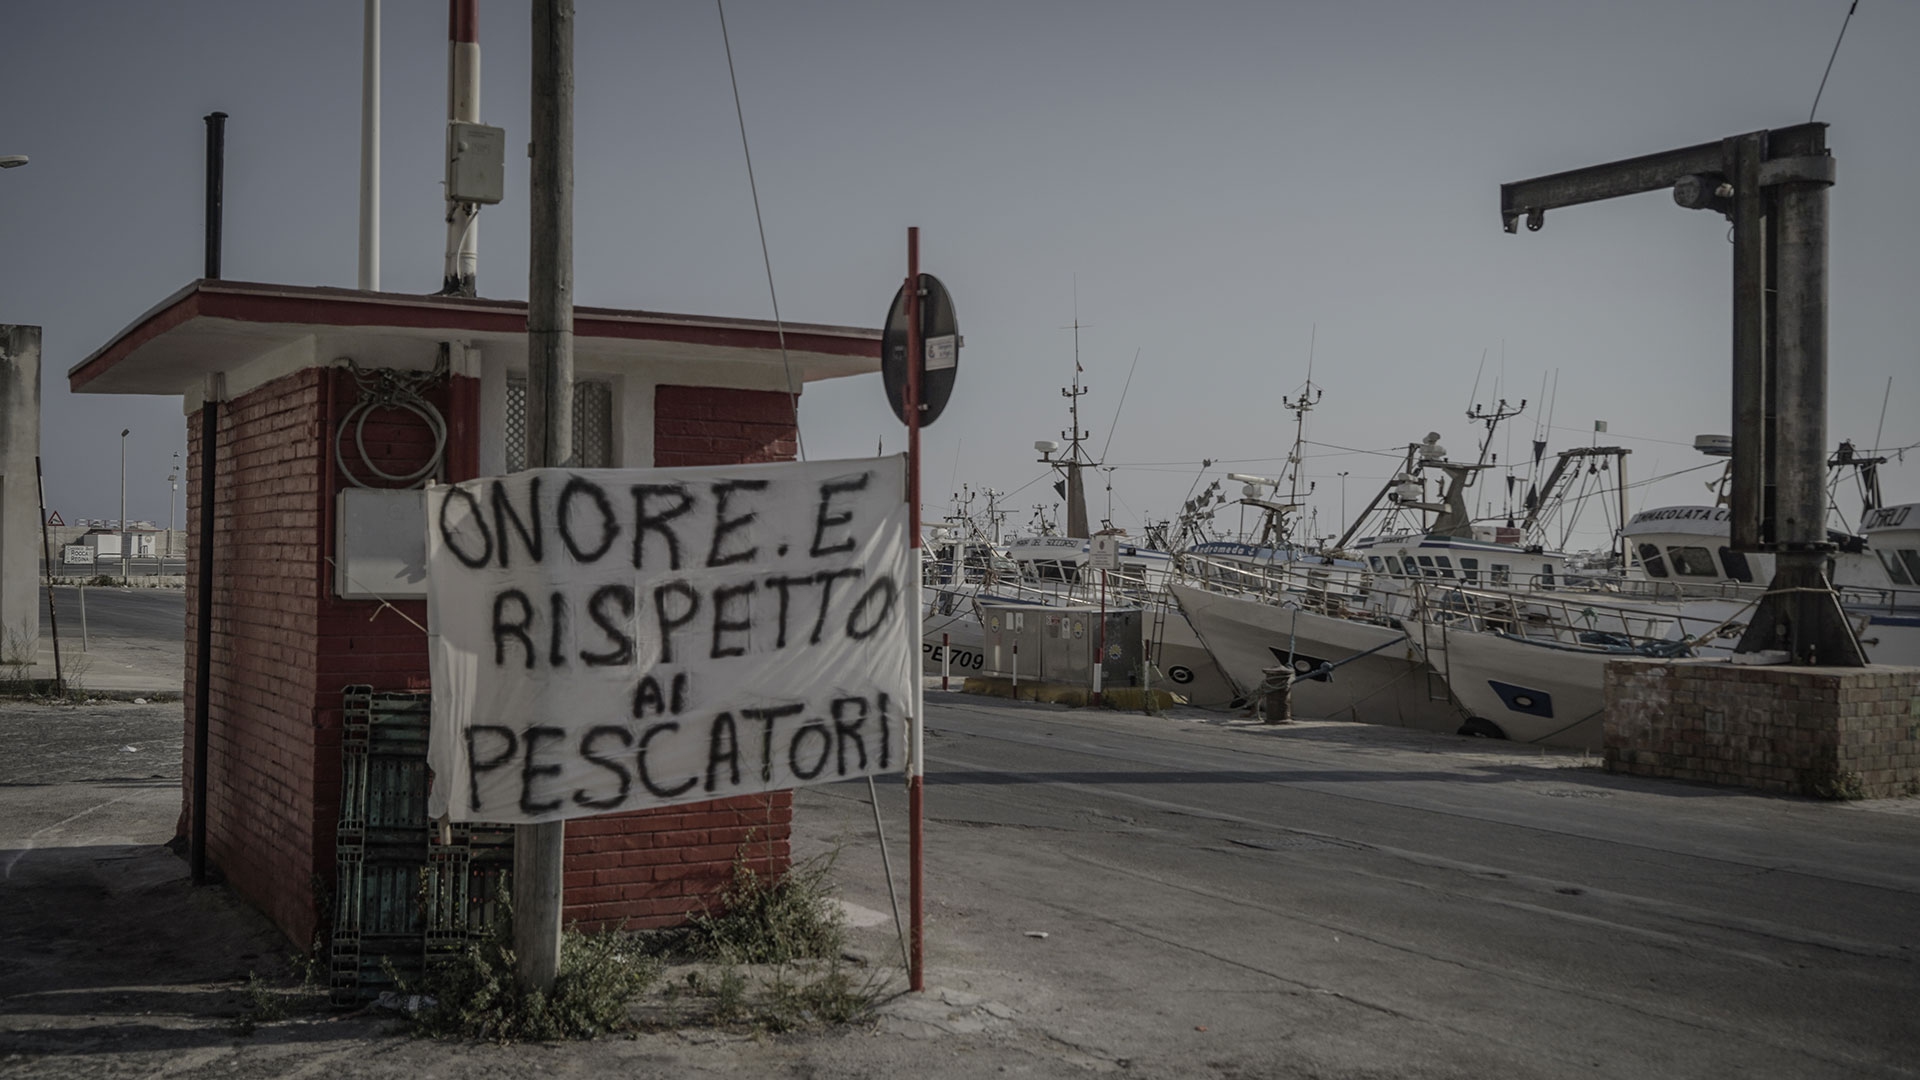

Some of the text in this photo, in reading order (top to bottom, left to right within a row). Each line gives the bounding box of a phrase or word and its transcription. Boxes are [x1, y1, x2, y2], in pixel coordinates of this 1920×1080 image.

[810, 470, 873, 558] E
[1634, 509, 1711, 523] IMMACOLATA
[1194, 545, 1245, 554] Andromeda
[493, 567, 899, 669] RISPETTO
[950, 649, 984, 670] 709
[633, 672, 687, 719] AI
[465, 692, 890, 814] PESCATORI
